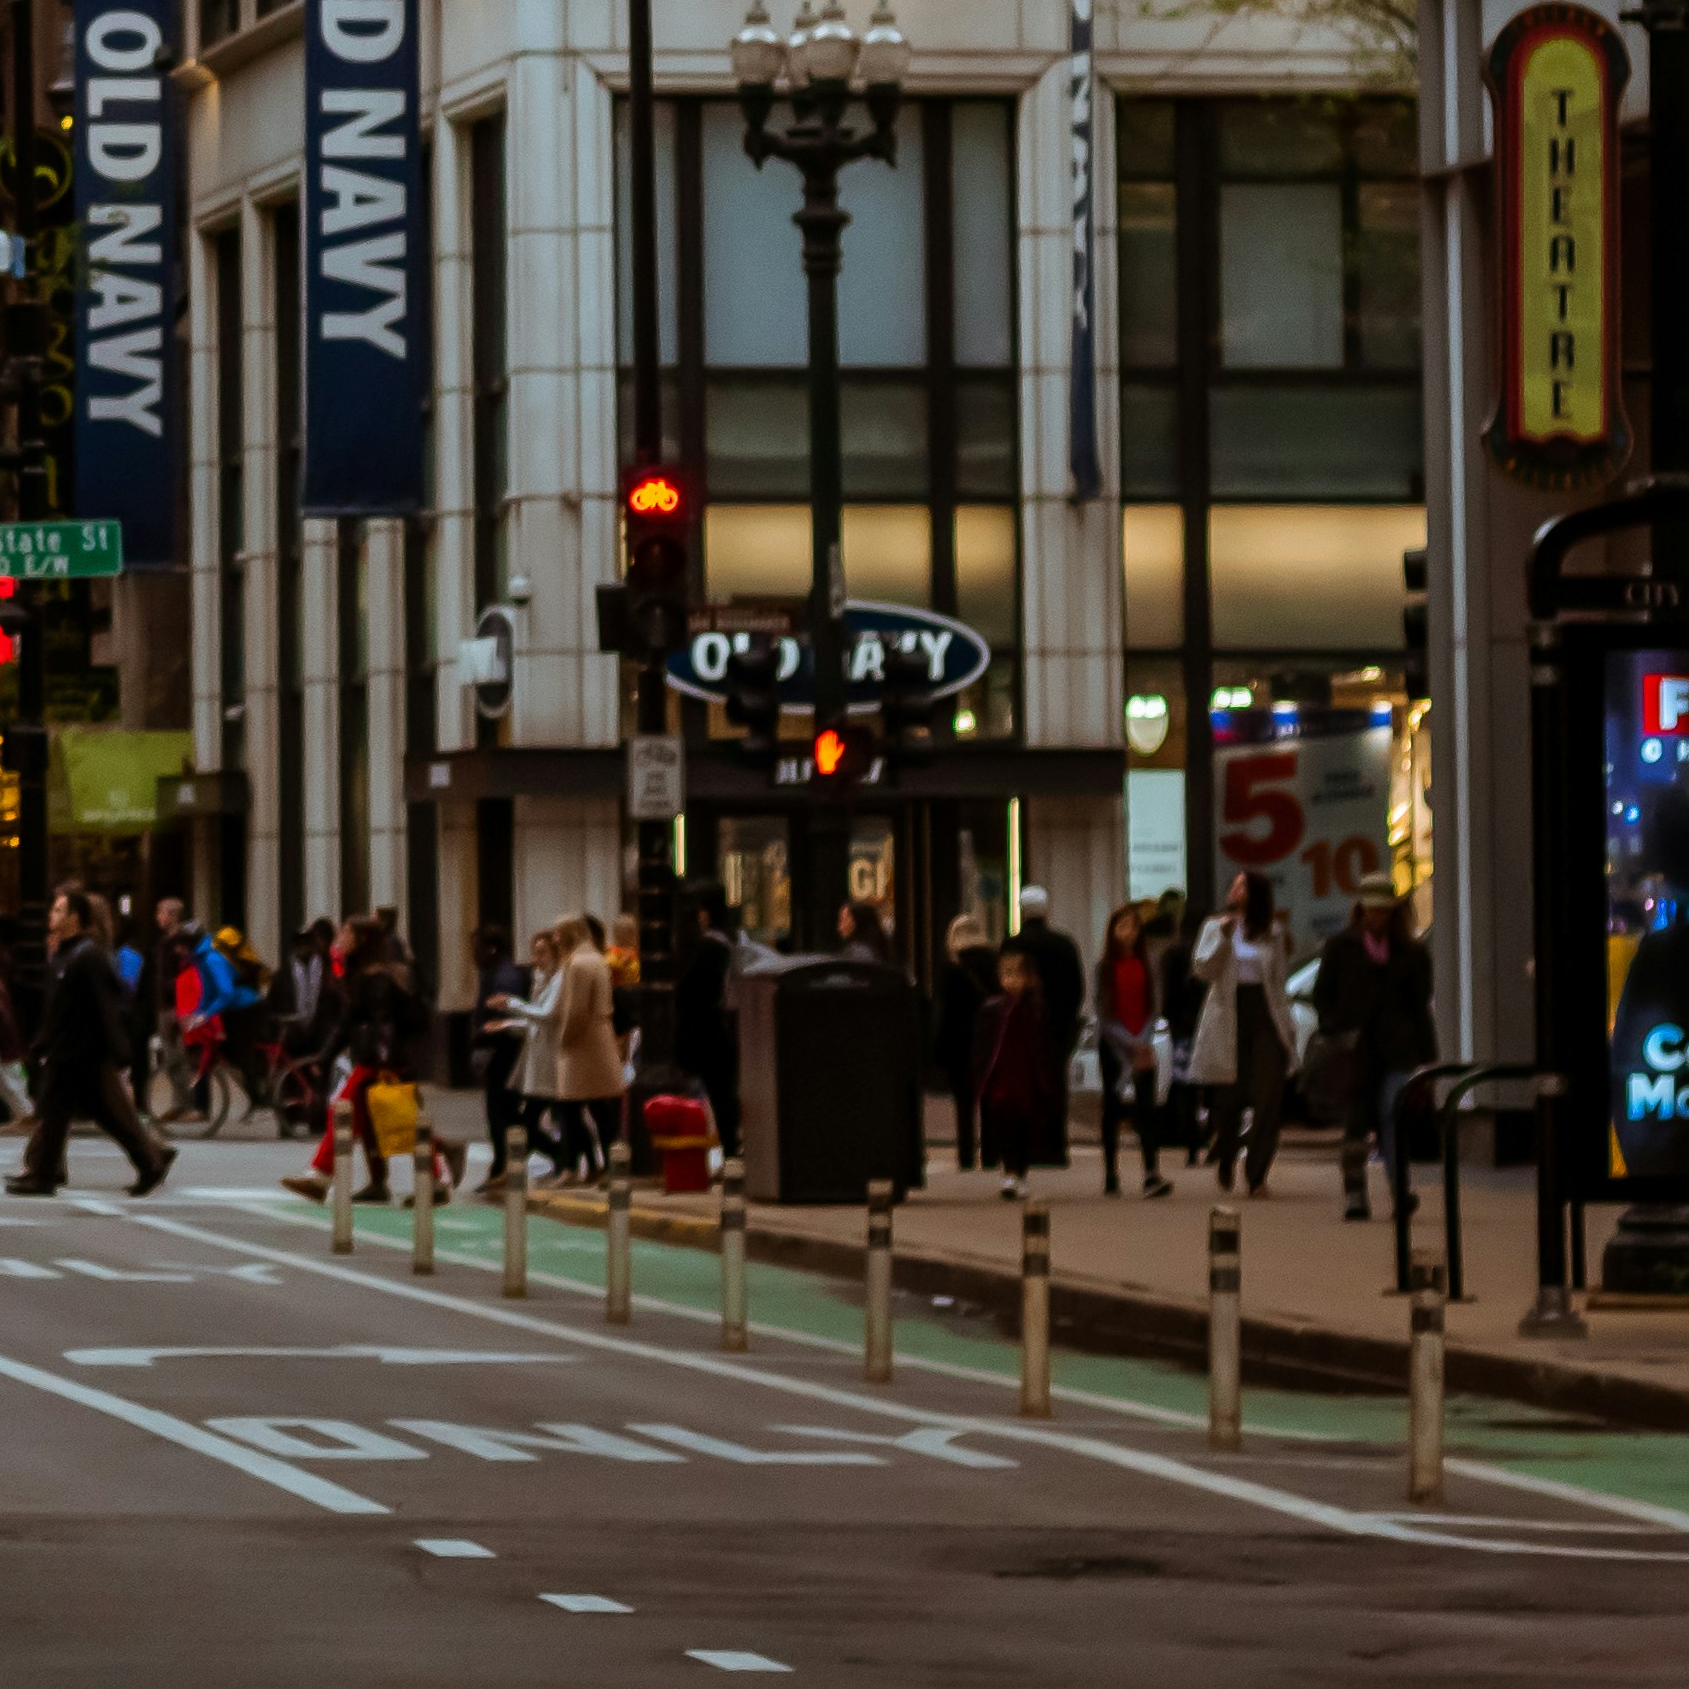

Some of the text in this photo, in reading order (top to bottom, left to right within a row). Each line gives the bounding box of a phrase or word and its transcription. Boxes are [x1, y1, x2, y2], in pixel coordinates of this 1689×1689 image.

[85, 10, 163, 438] OLD NAVY
[321, 90, 407, 360] NAVY
[1549, 89, 1577, 420] THEATRE
[80, 523, 109, 553] St
[1221, 753, 1303, 863] 5
[1303, 835, 1377, 898] 10
[205, 1416, 1020, 1468] ONLY
